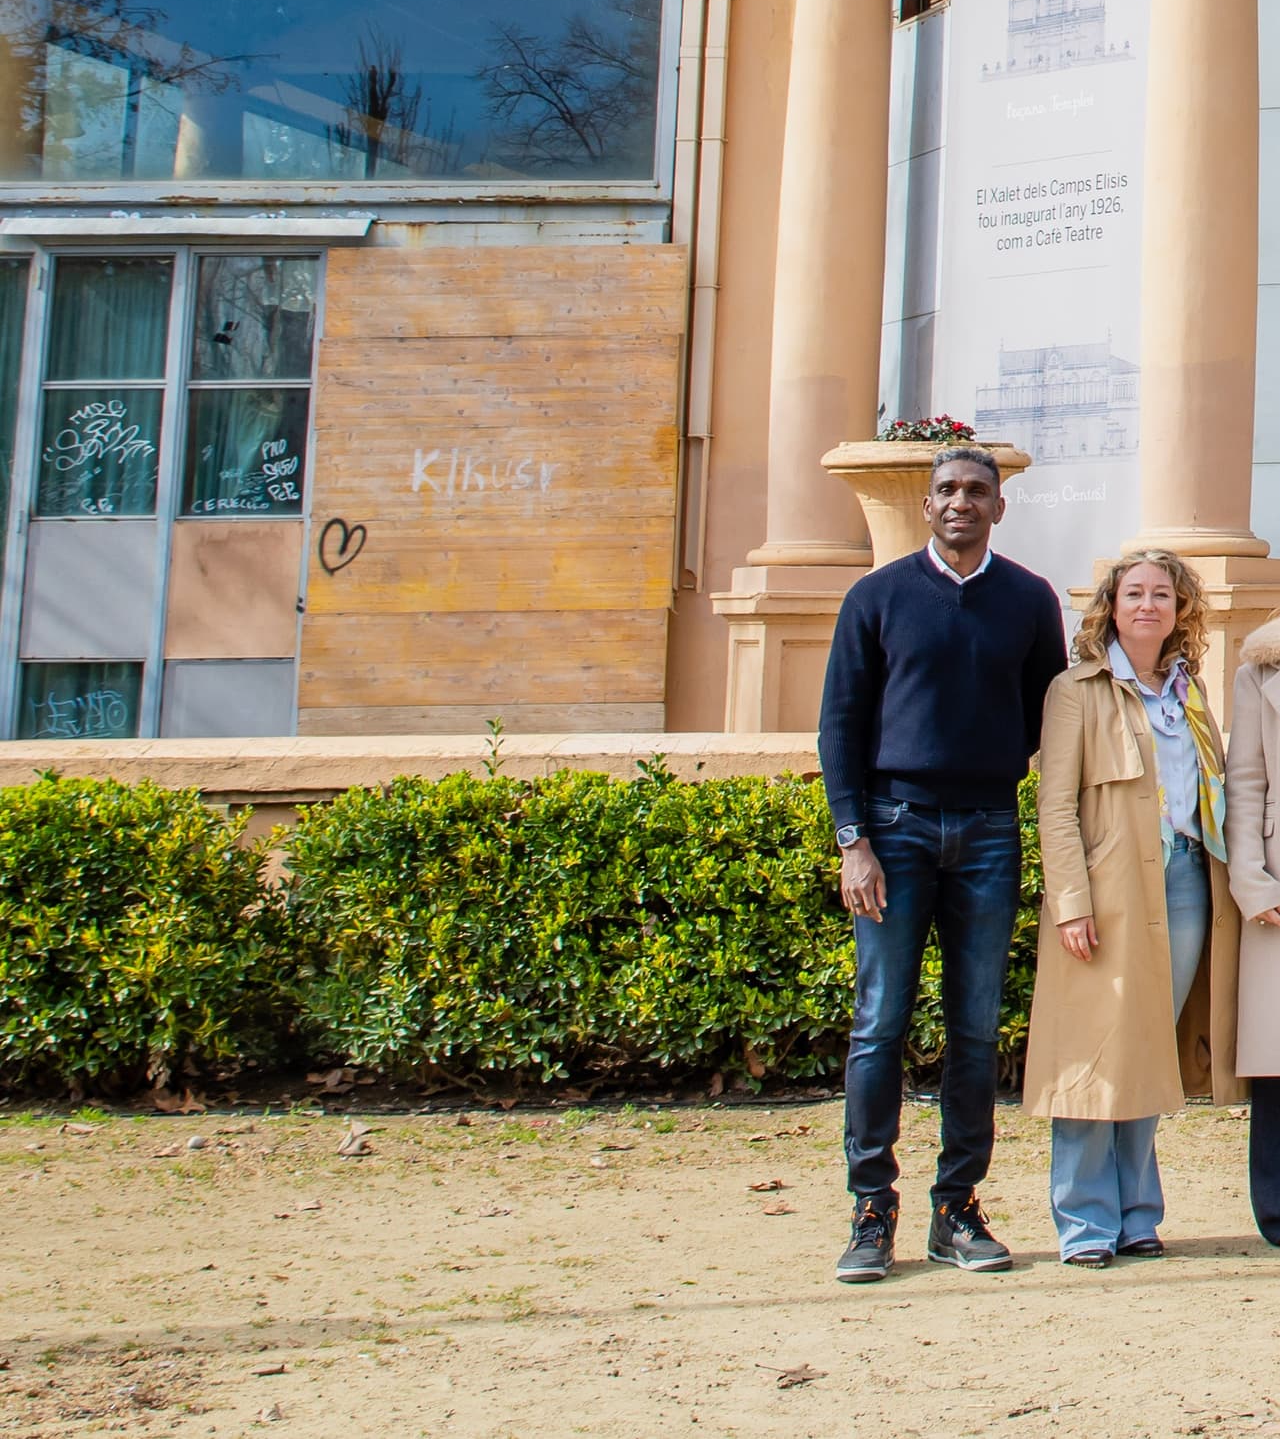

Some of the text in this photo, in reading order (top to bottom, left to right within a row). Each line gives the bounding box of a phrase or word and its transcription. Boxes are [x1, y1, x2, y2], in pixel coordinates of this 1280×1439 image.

[976, 172, 1128, 205] El Xalet dels Camps Elisis
[978, 212, 998, 229] fou
[1000, 206, 1057, 228] inaugurat
[1059, 202, 1088, 221] l'any
[996, 236, 1023, 252] com
[1026, 234, 1033, 248] a
[1065, 224, 1104, 243] Teatre
